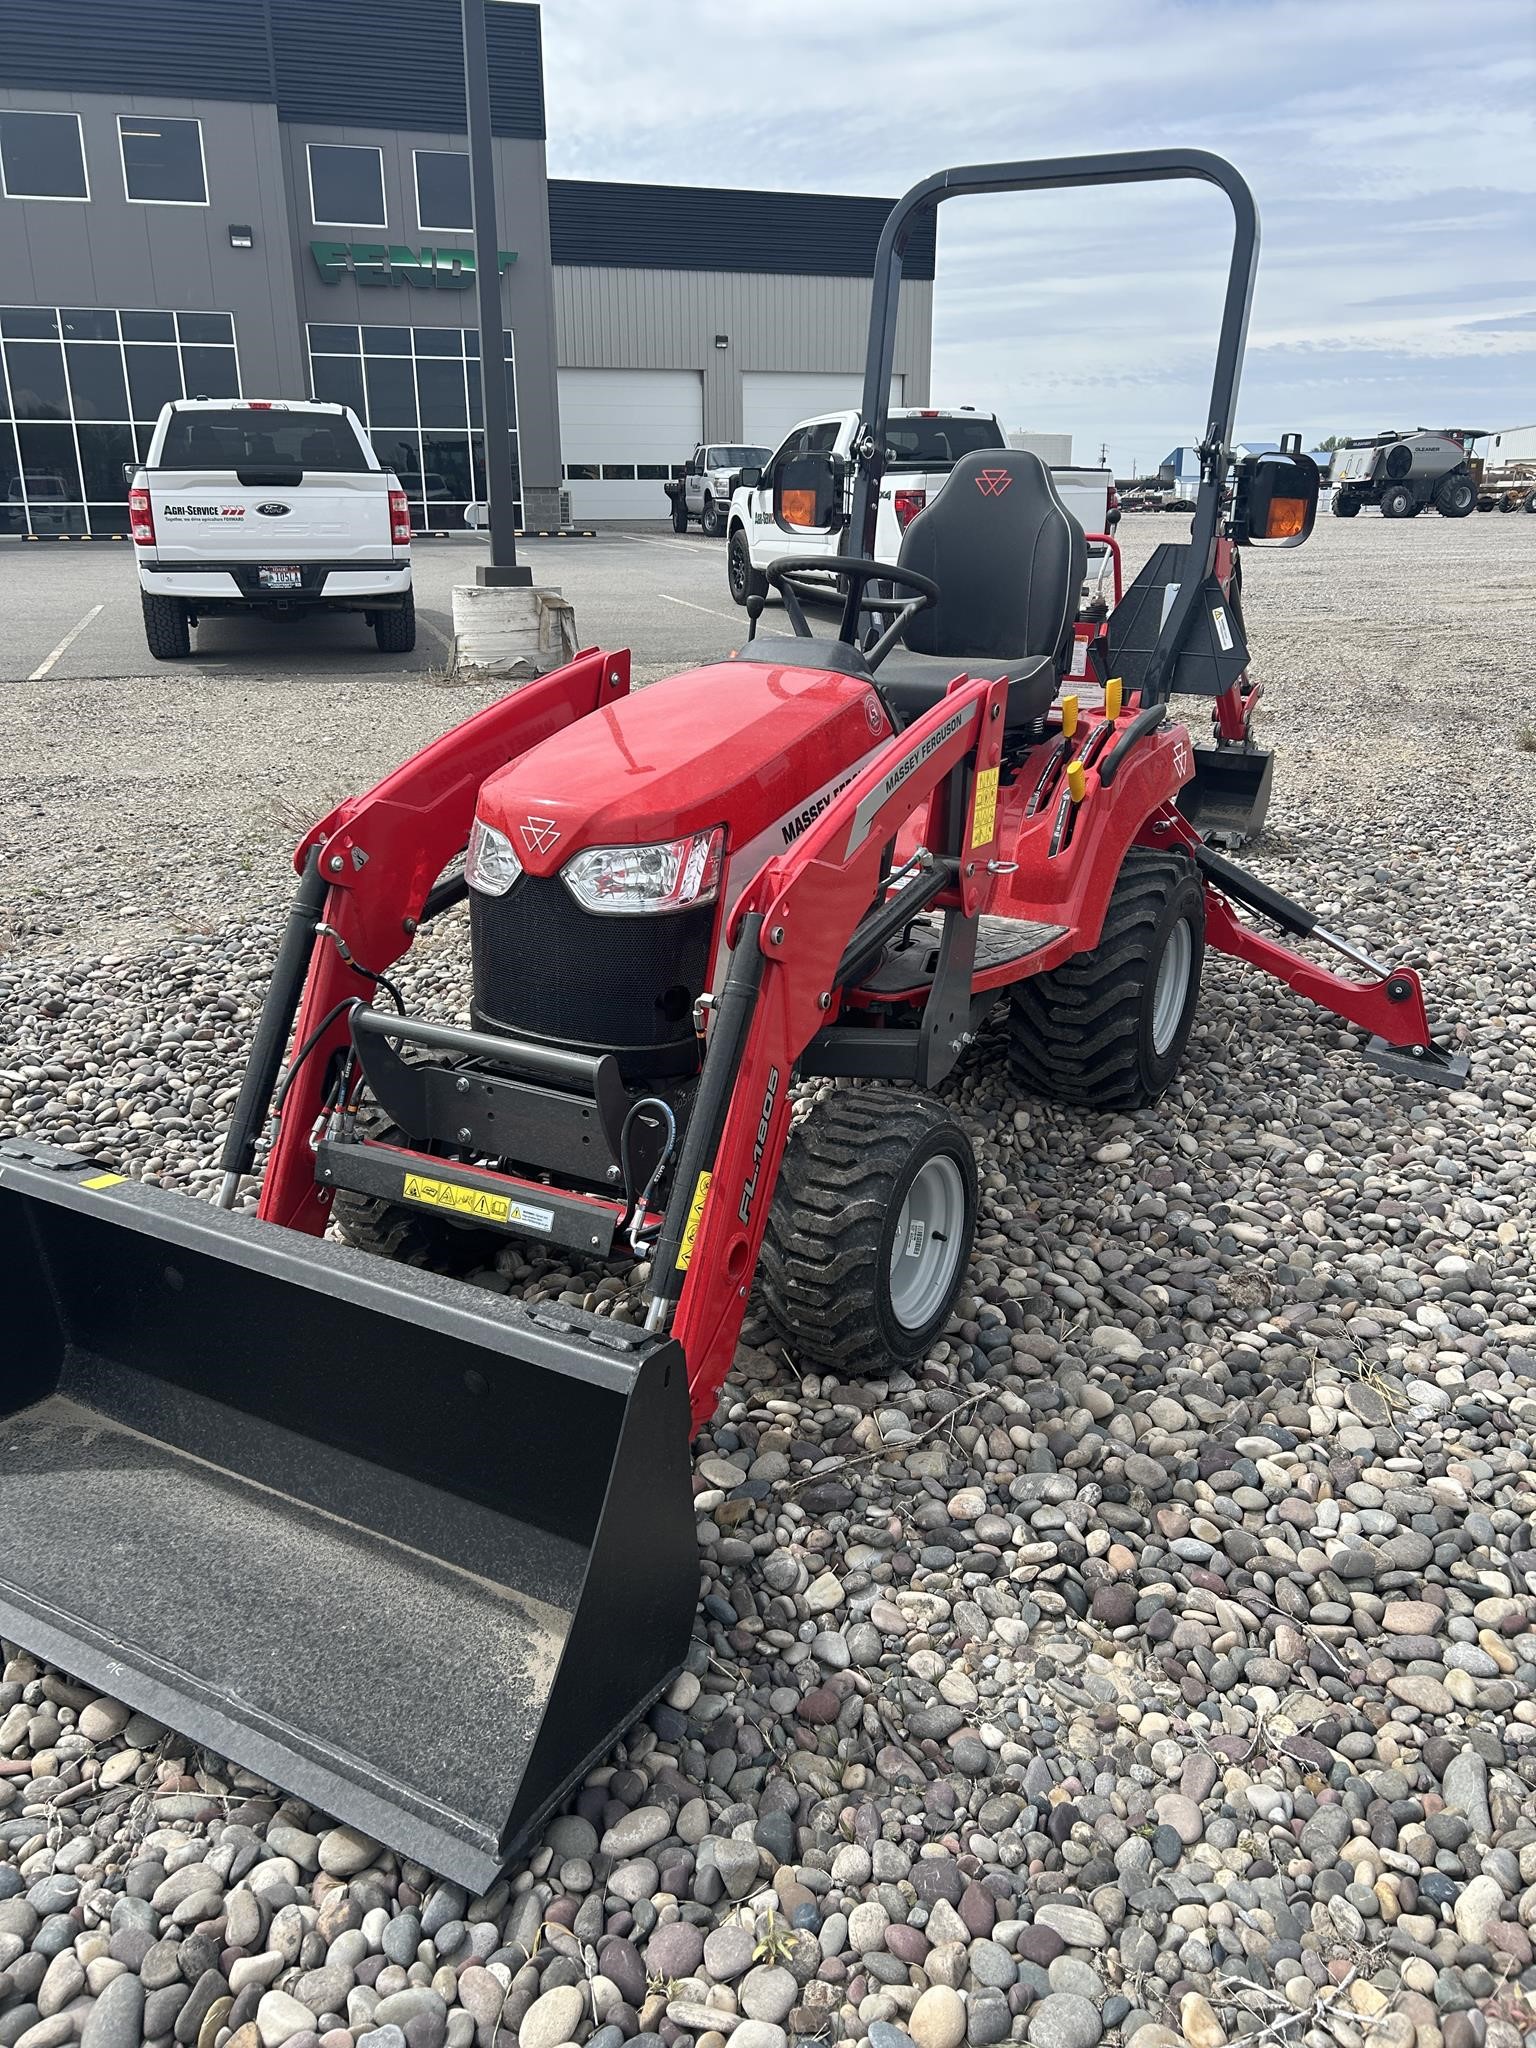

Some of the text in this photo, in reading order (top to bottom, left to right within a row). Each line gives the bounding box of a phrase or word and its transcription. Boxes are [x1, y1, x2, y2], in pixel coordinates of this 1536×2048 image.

[163, 505, 219, 516] AGRI-SERVICE
[885, 754, 920, 794] MASSEY
[921, 713, 963, 758] FERGUSON
[781, 793, 831, 845] MASSEY
